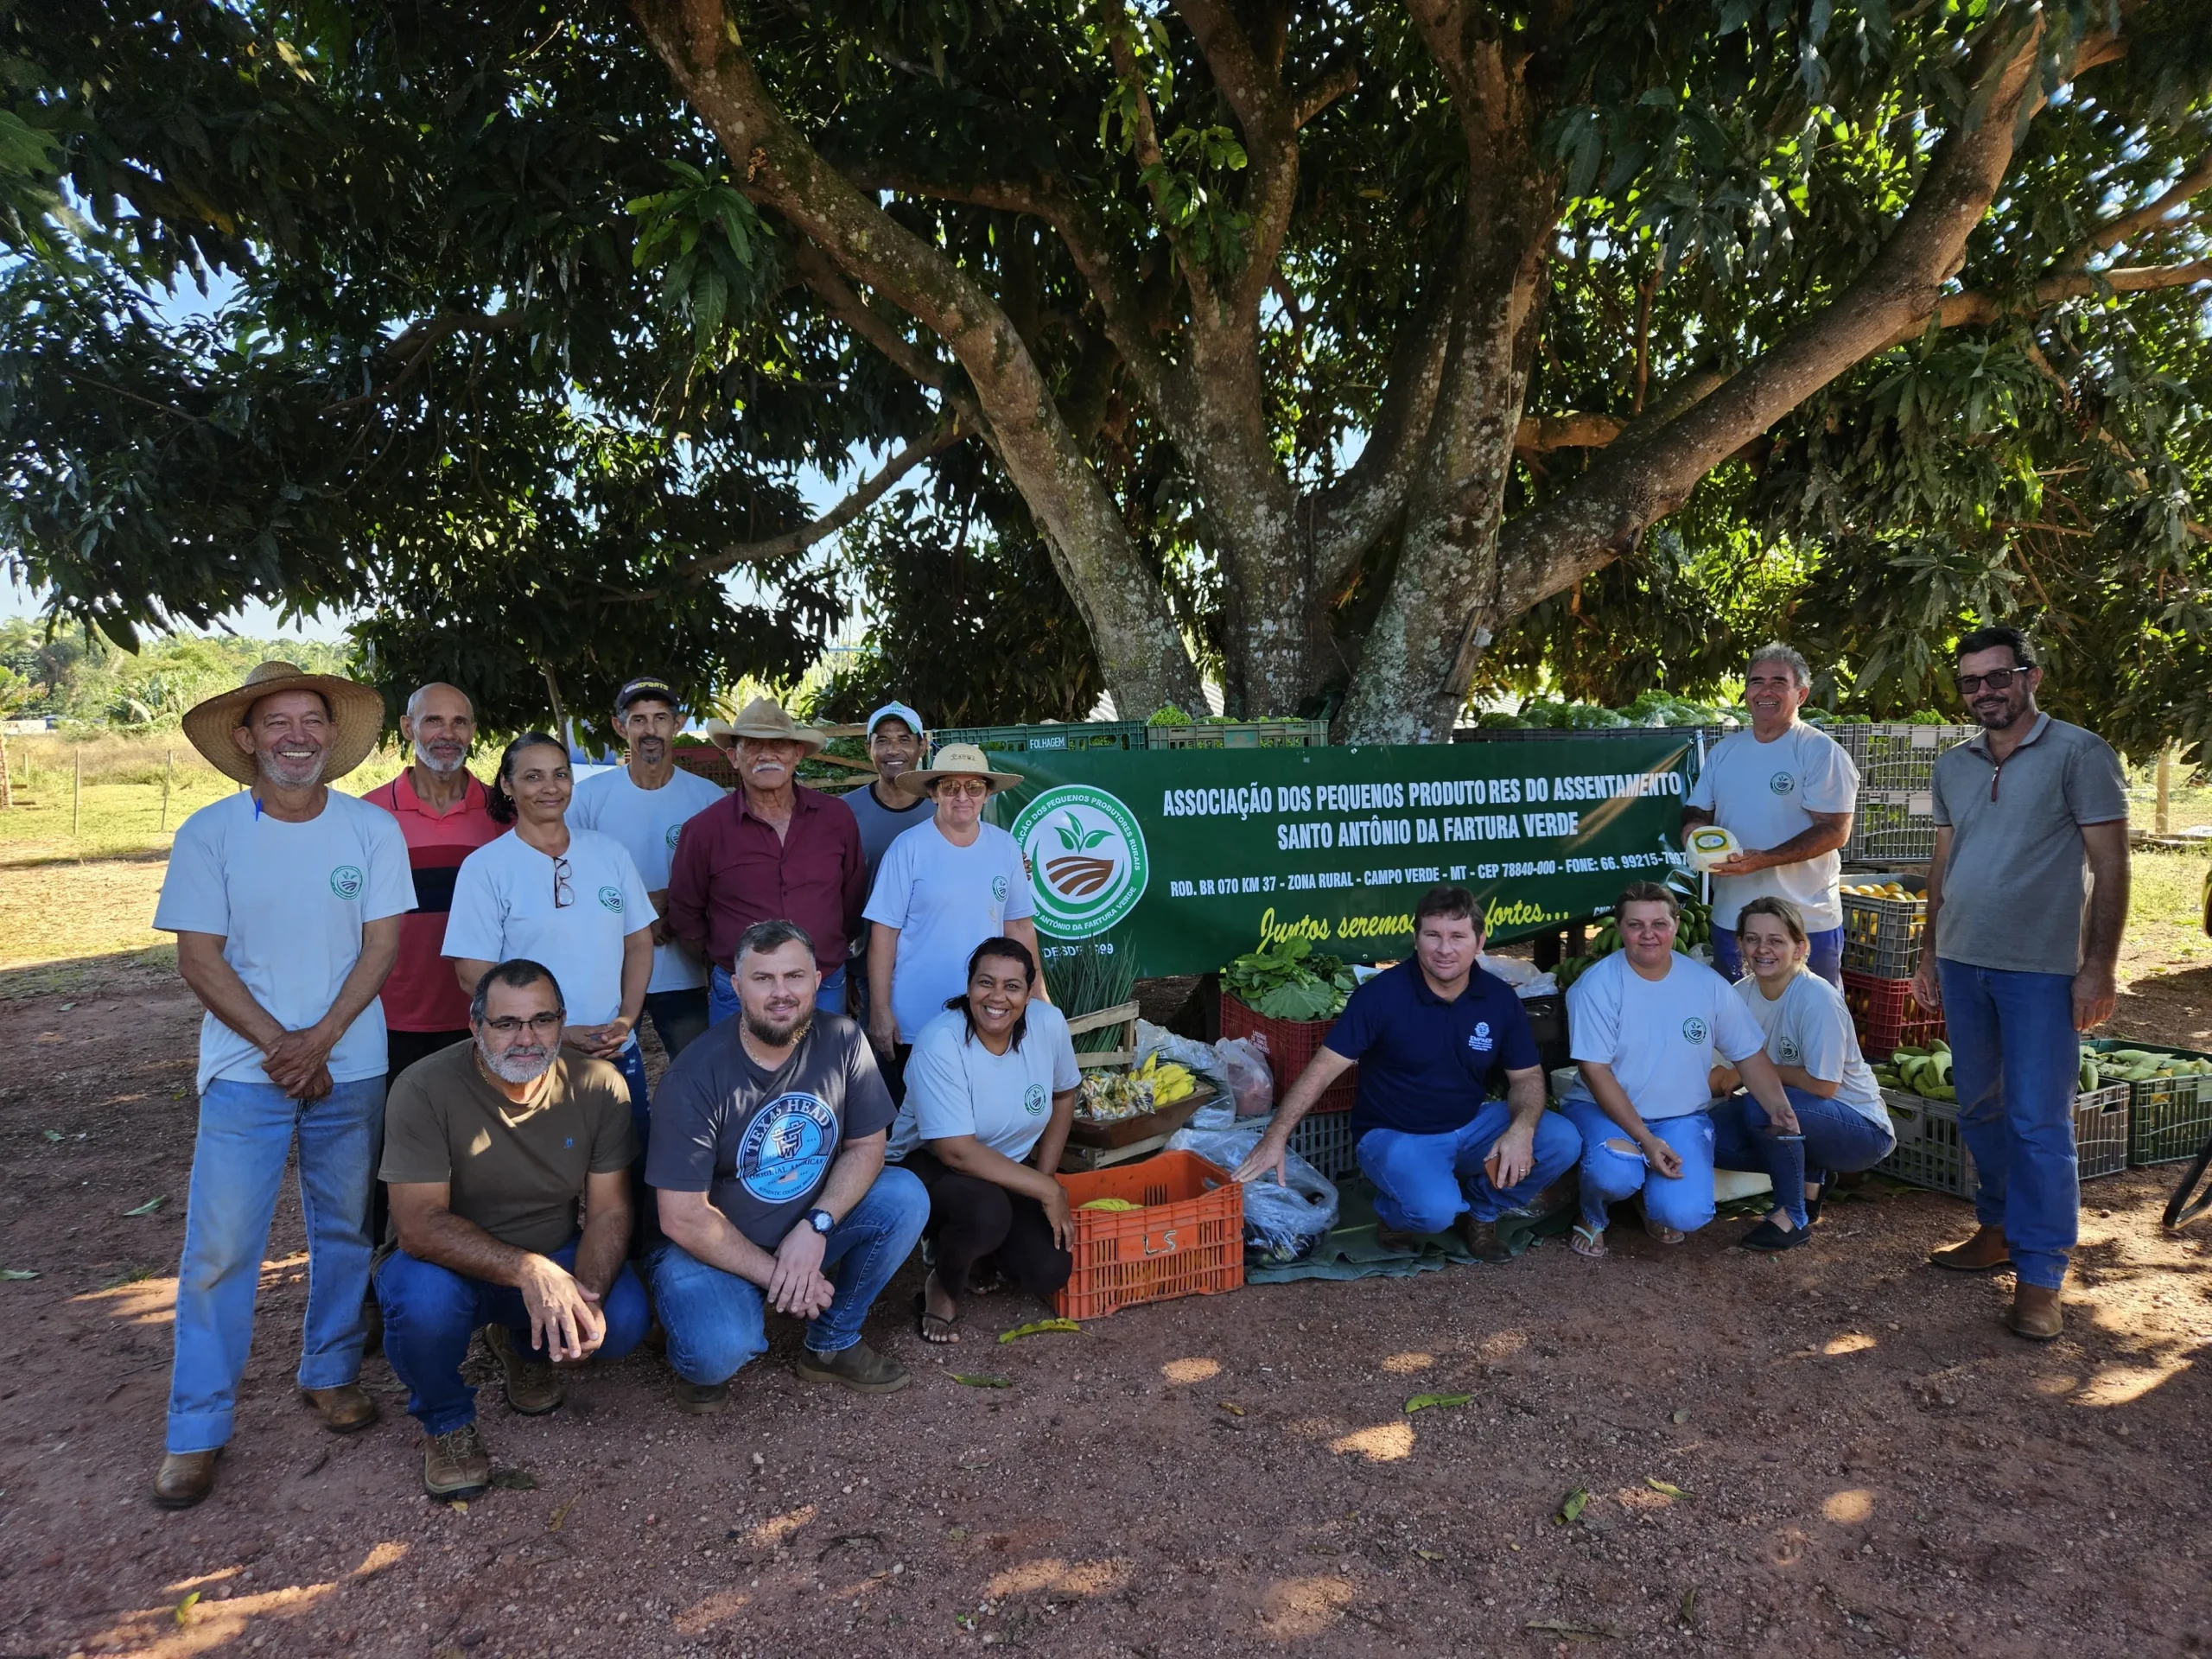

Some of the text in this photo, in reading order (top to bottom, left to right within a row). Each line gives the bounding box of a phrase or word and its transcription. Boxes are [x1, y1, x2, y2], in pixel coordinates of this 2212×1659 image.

[1029, 736, 1065, 749] FOLHAGEM
[1163, 781, 1272, 821] ASSOCIAÇÃO
[1277, 785, 1312, 812] DOS
[1316, 783, 1404, 813] PEQUENOS
[1525, 777, 1548, 803] DO
[1553, 772, 1682, 801] ASSENTAMENTO
[1031, 805, 1047, 820] DOS
[1046, 794, 1090, 809] PEQUENOS
[1090, 797, 1133, 838] PRODUTORES
[1128, 838, 1141, 871] RURAIS
[1277, 811, 1579, 850] SANTO ANTÔNIO DA FARTURA VERDE
[1170, 880, 1197, 897] ROD.
[1199, 880, 1215, 895] BR
[1217, 878, 1239, 894] 070
[1242, 877, 1260, 893] KM
[1262, 876, 1276, 892] 37
[1287, 874, 1316, 890] ZONA
[1319, 872, 1354, 888] RURAL
[1363, 869, 1402, 886] CAMPO
[1404, 867, 1440, 883] VERDE
[1450, 866, 1466, 880] MT
[1478, 863, 1499, 879] CEP
[1502, 860, 1555, 878] 78840-000
[1565, 857, 1598, 874] FONE:
[1600, 856, 1620, 871] 66.
[1621, 851, 1687, 869] 99215-7997
[1084, 908, 1117, 929] FARTURA
[1116, 886, 1137, 909] VERDE
[1256, 907, 1331, 954] Juntos
[747, 1099, 830, 1153] TEXAS HEAD
[749, 1166, 787, 1180] ORIGINAL
[782, 1185, 802, 1195] COUNTRY
